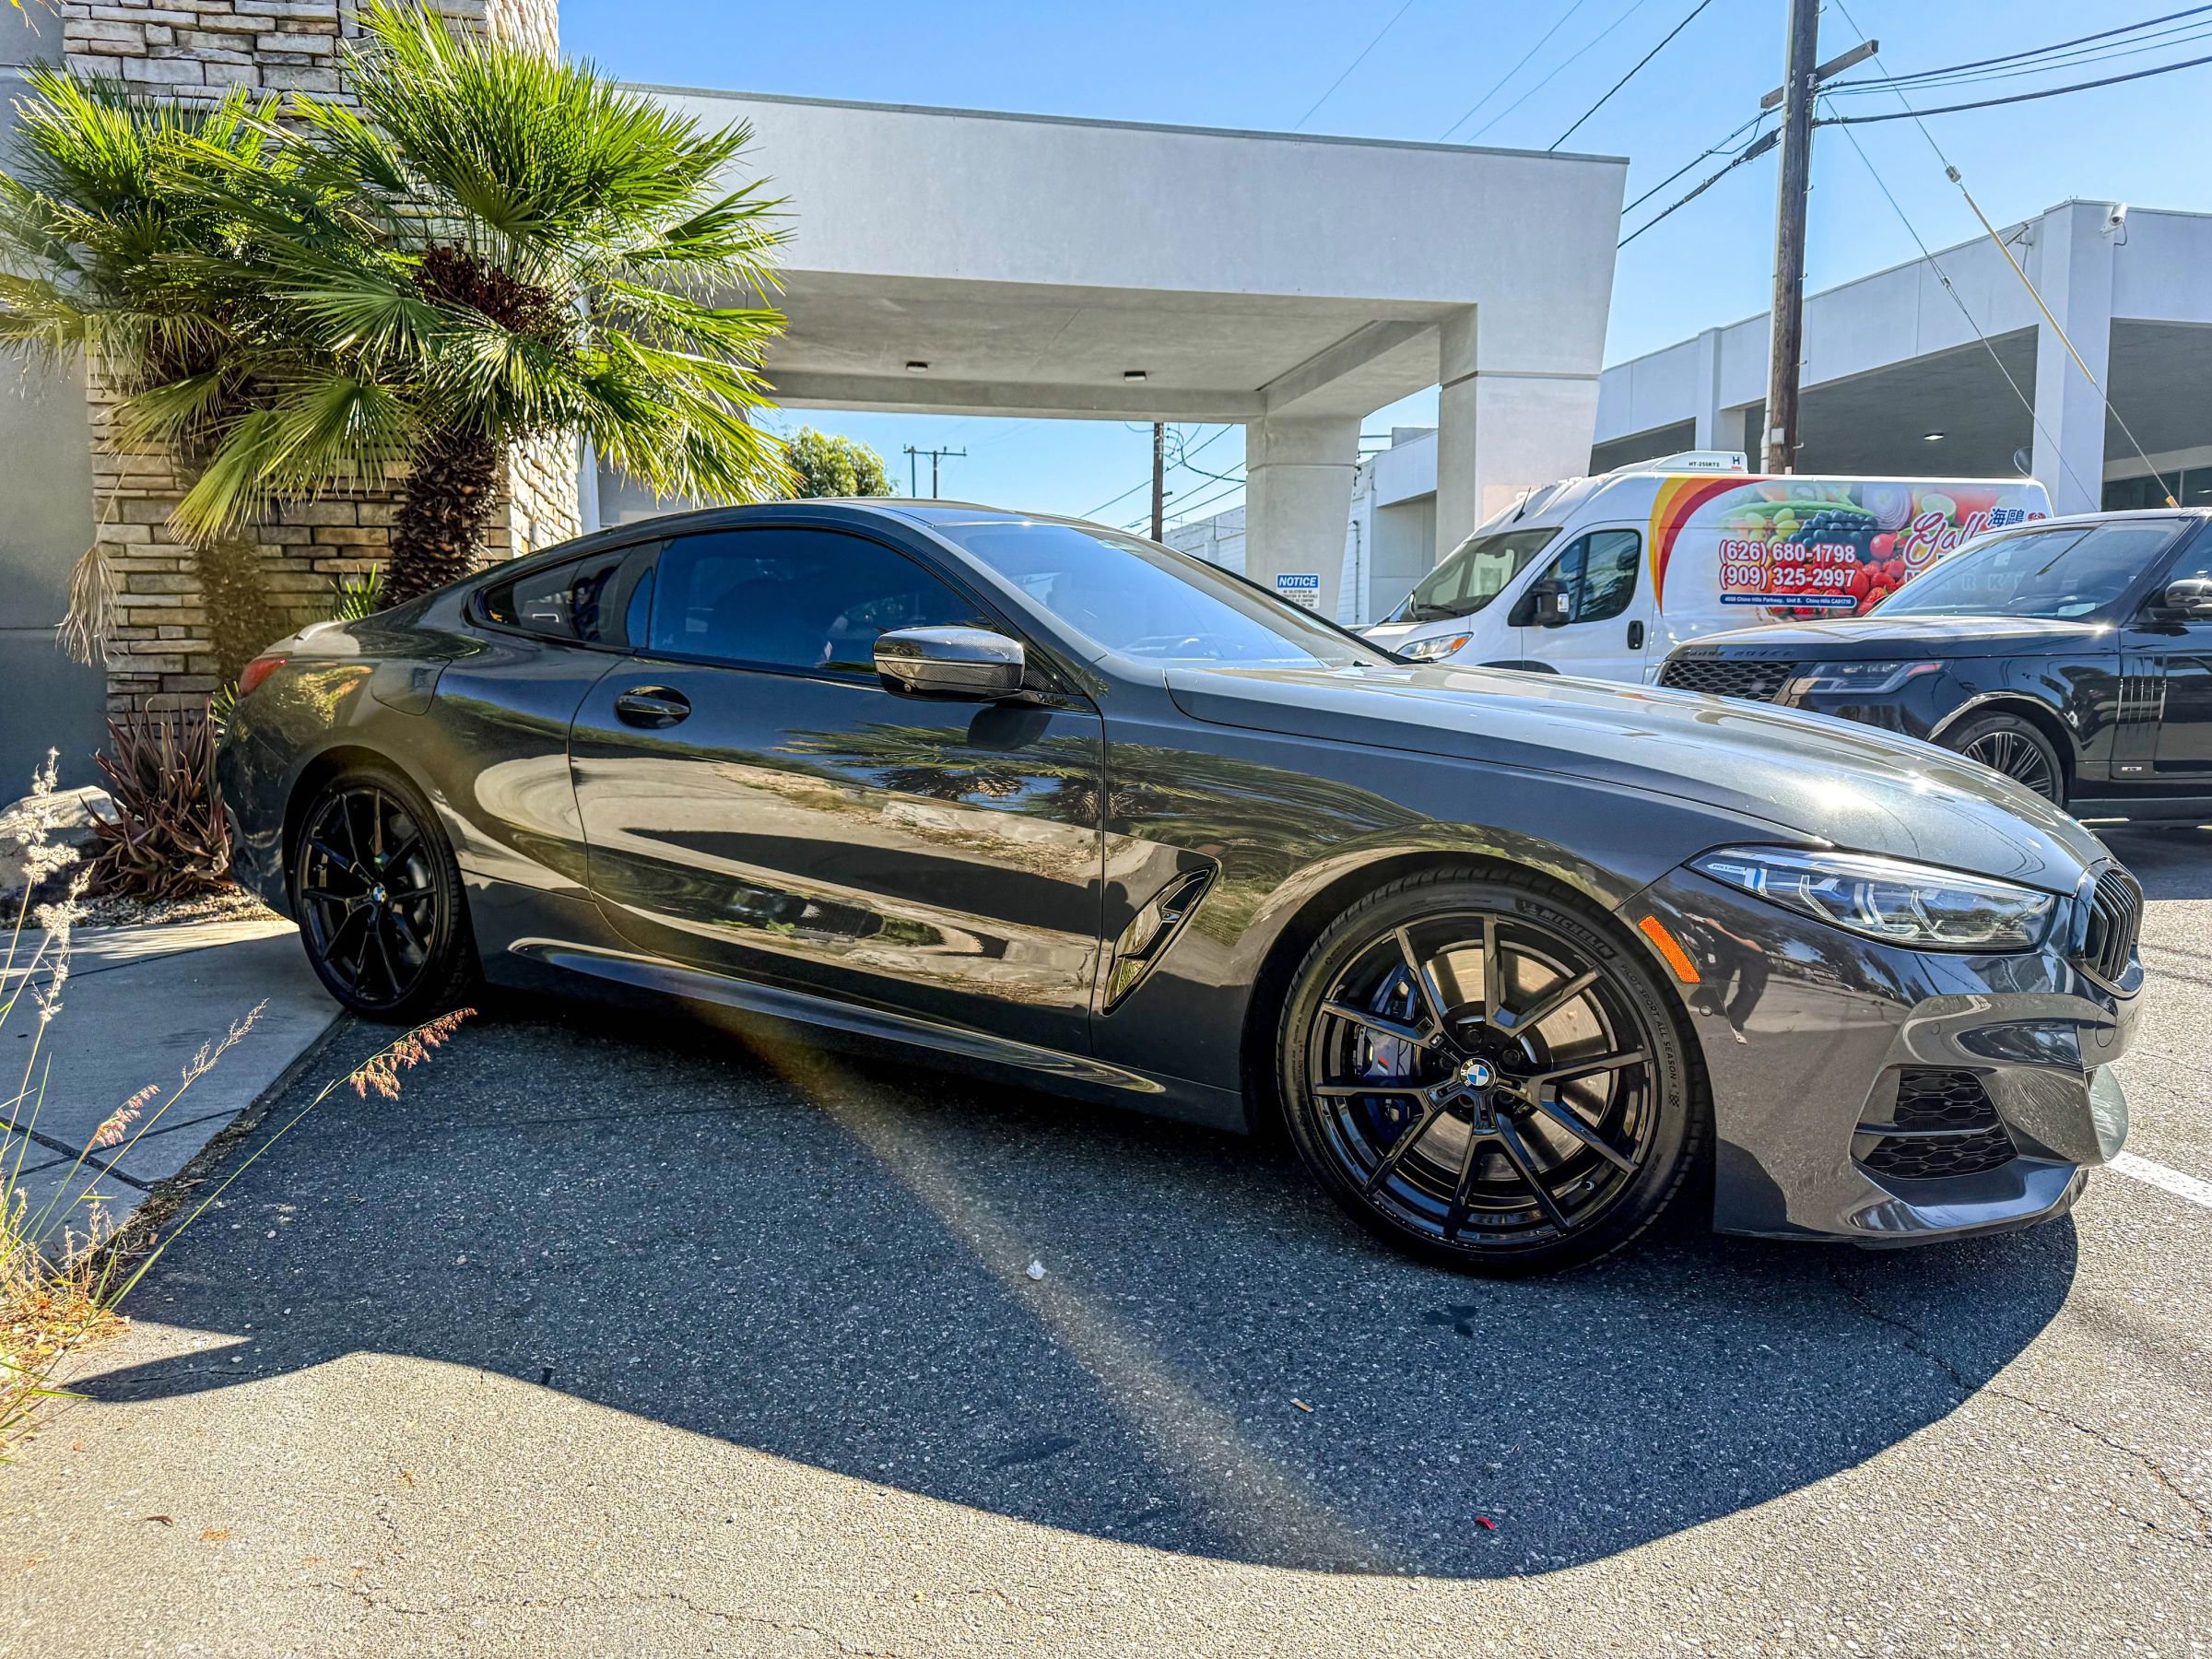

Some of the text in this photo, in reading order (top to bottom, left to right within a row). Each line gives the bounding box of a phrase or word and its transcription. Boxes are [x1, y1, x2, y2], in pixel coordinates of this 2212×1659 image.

[1720, 540, 1855, 565] (626) 680-1798
[1278, 577, 1317, 586] NOTICE
[1720, 564, 1855, 590] (909) 325-2997
[1542, 910, 1615, 959] MICHELIN
[1620, 965, 1641, 988] PILOT
[1640, 989, 1660, 1017] SPORT
[1656, 1020, 1667, 1038] ALL
[1663, 1041, 1677, 1079] SEASON
